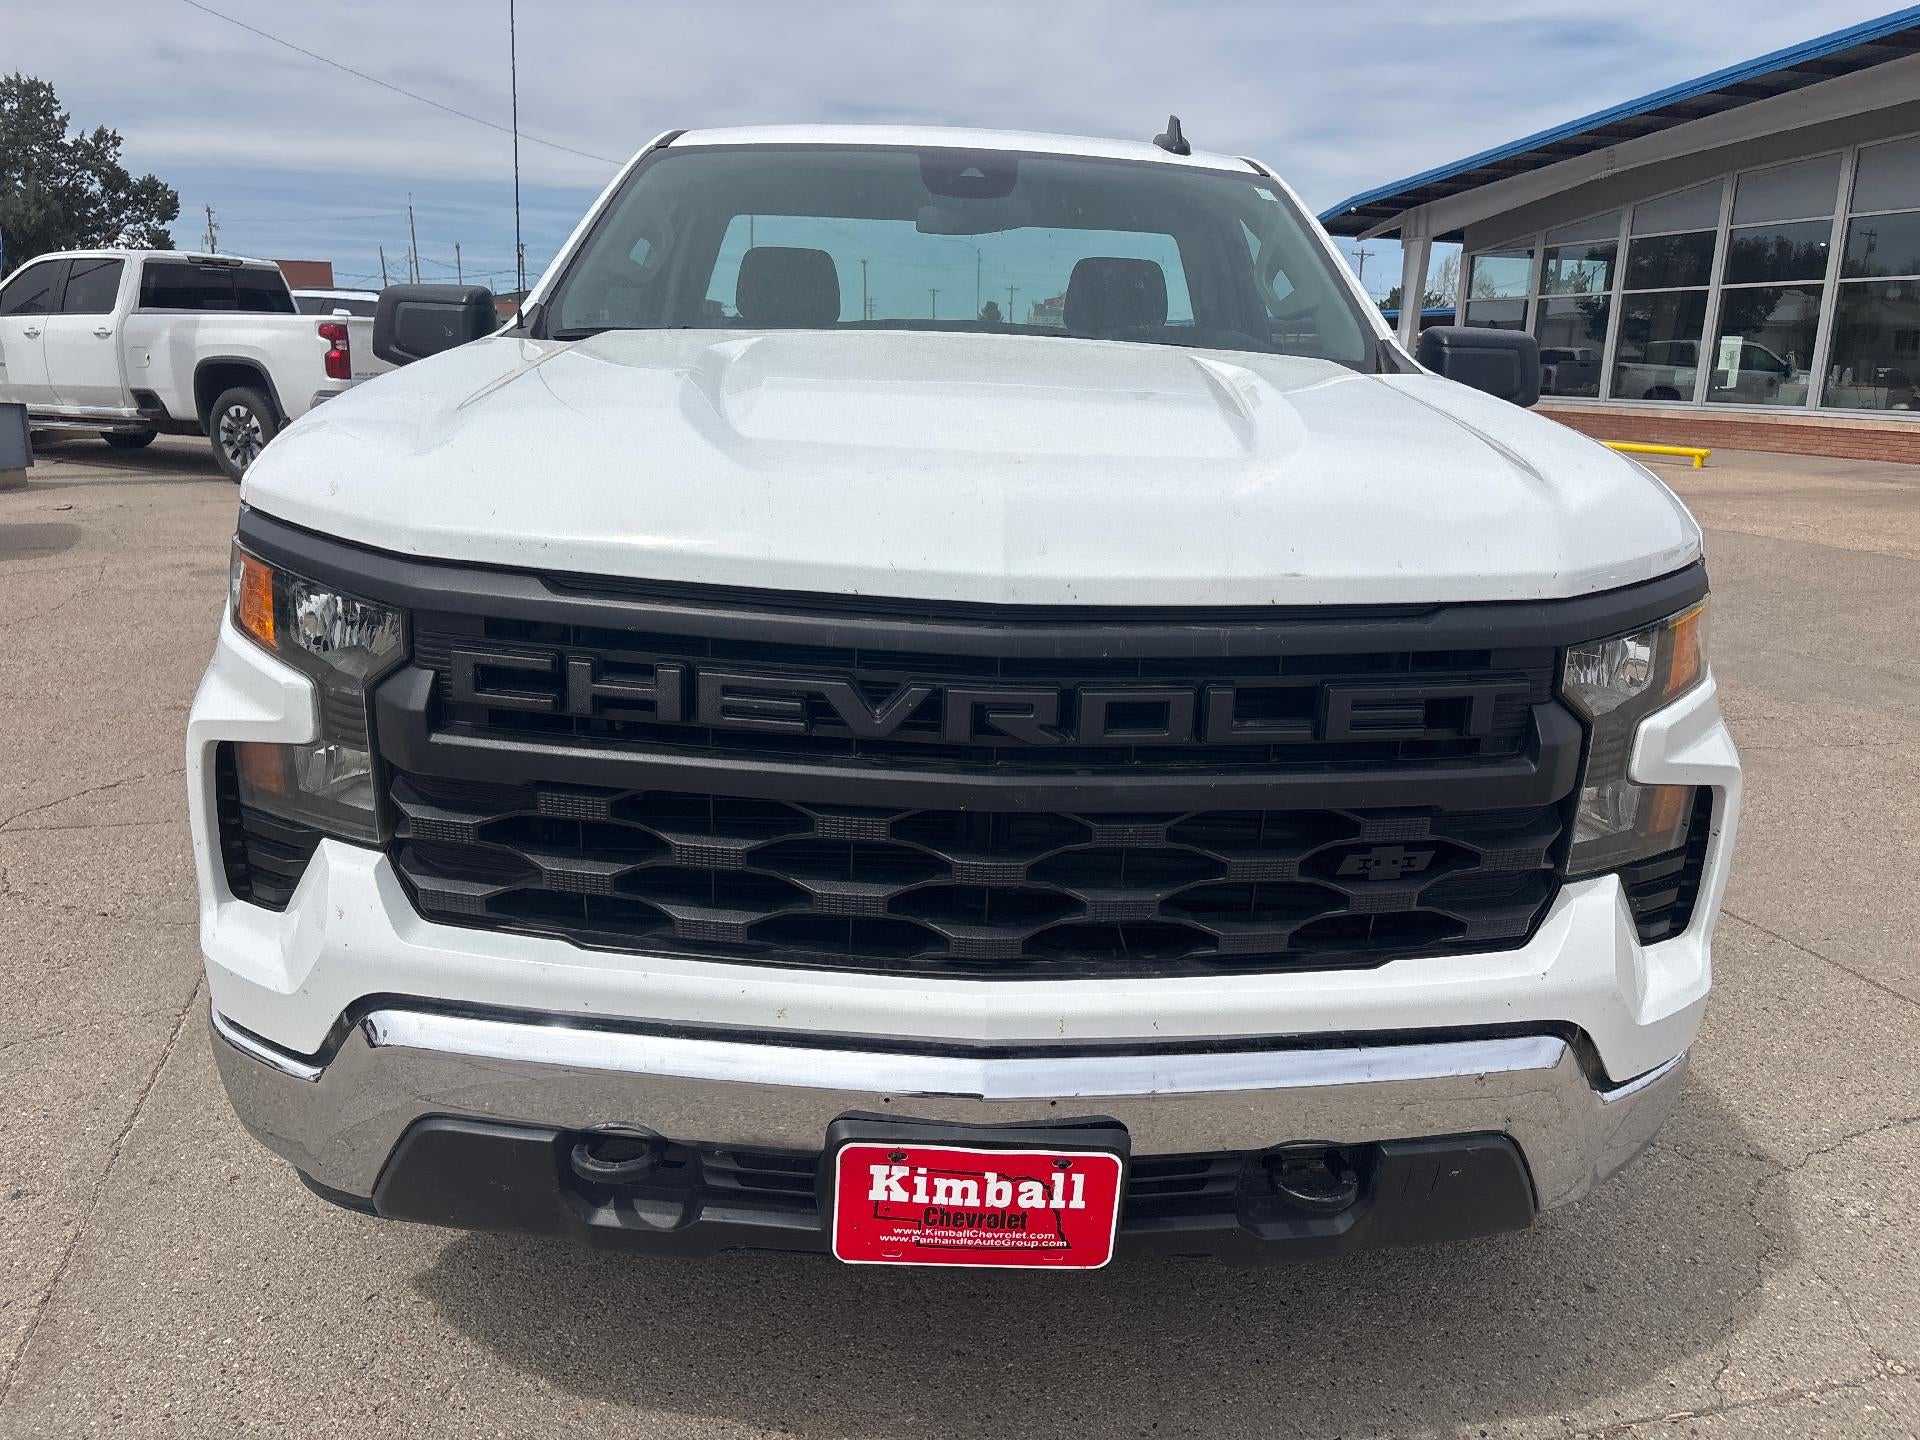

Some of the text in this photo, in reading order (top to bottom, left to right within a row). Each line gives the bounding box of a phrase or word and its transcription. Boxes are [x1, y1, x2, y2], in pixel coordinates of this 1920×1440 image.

[450, 645, 1530, 744] CHEVROLET
[868, 1164, 1086, 1209] Kimball
[923, 1207, 1029, 1230] Chevrolet
[880, 1234, 1067, 1248] www.PanhandleAutoGroup.com
[893, 1228, 1055, 1240] www.KimballChevrolet.com
